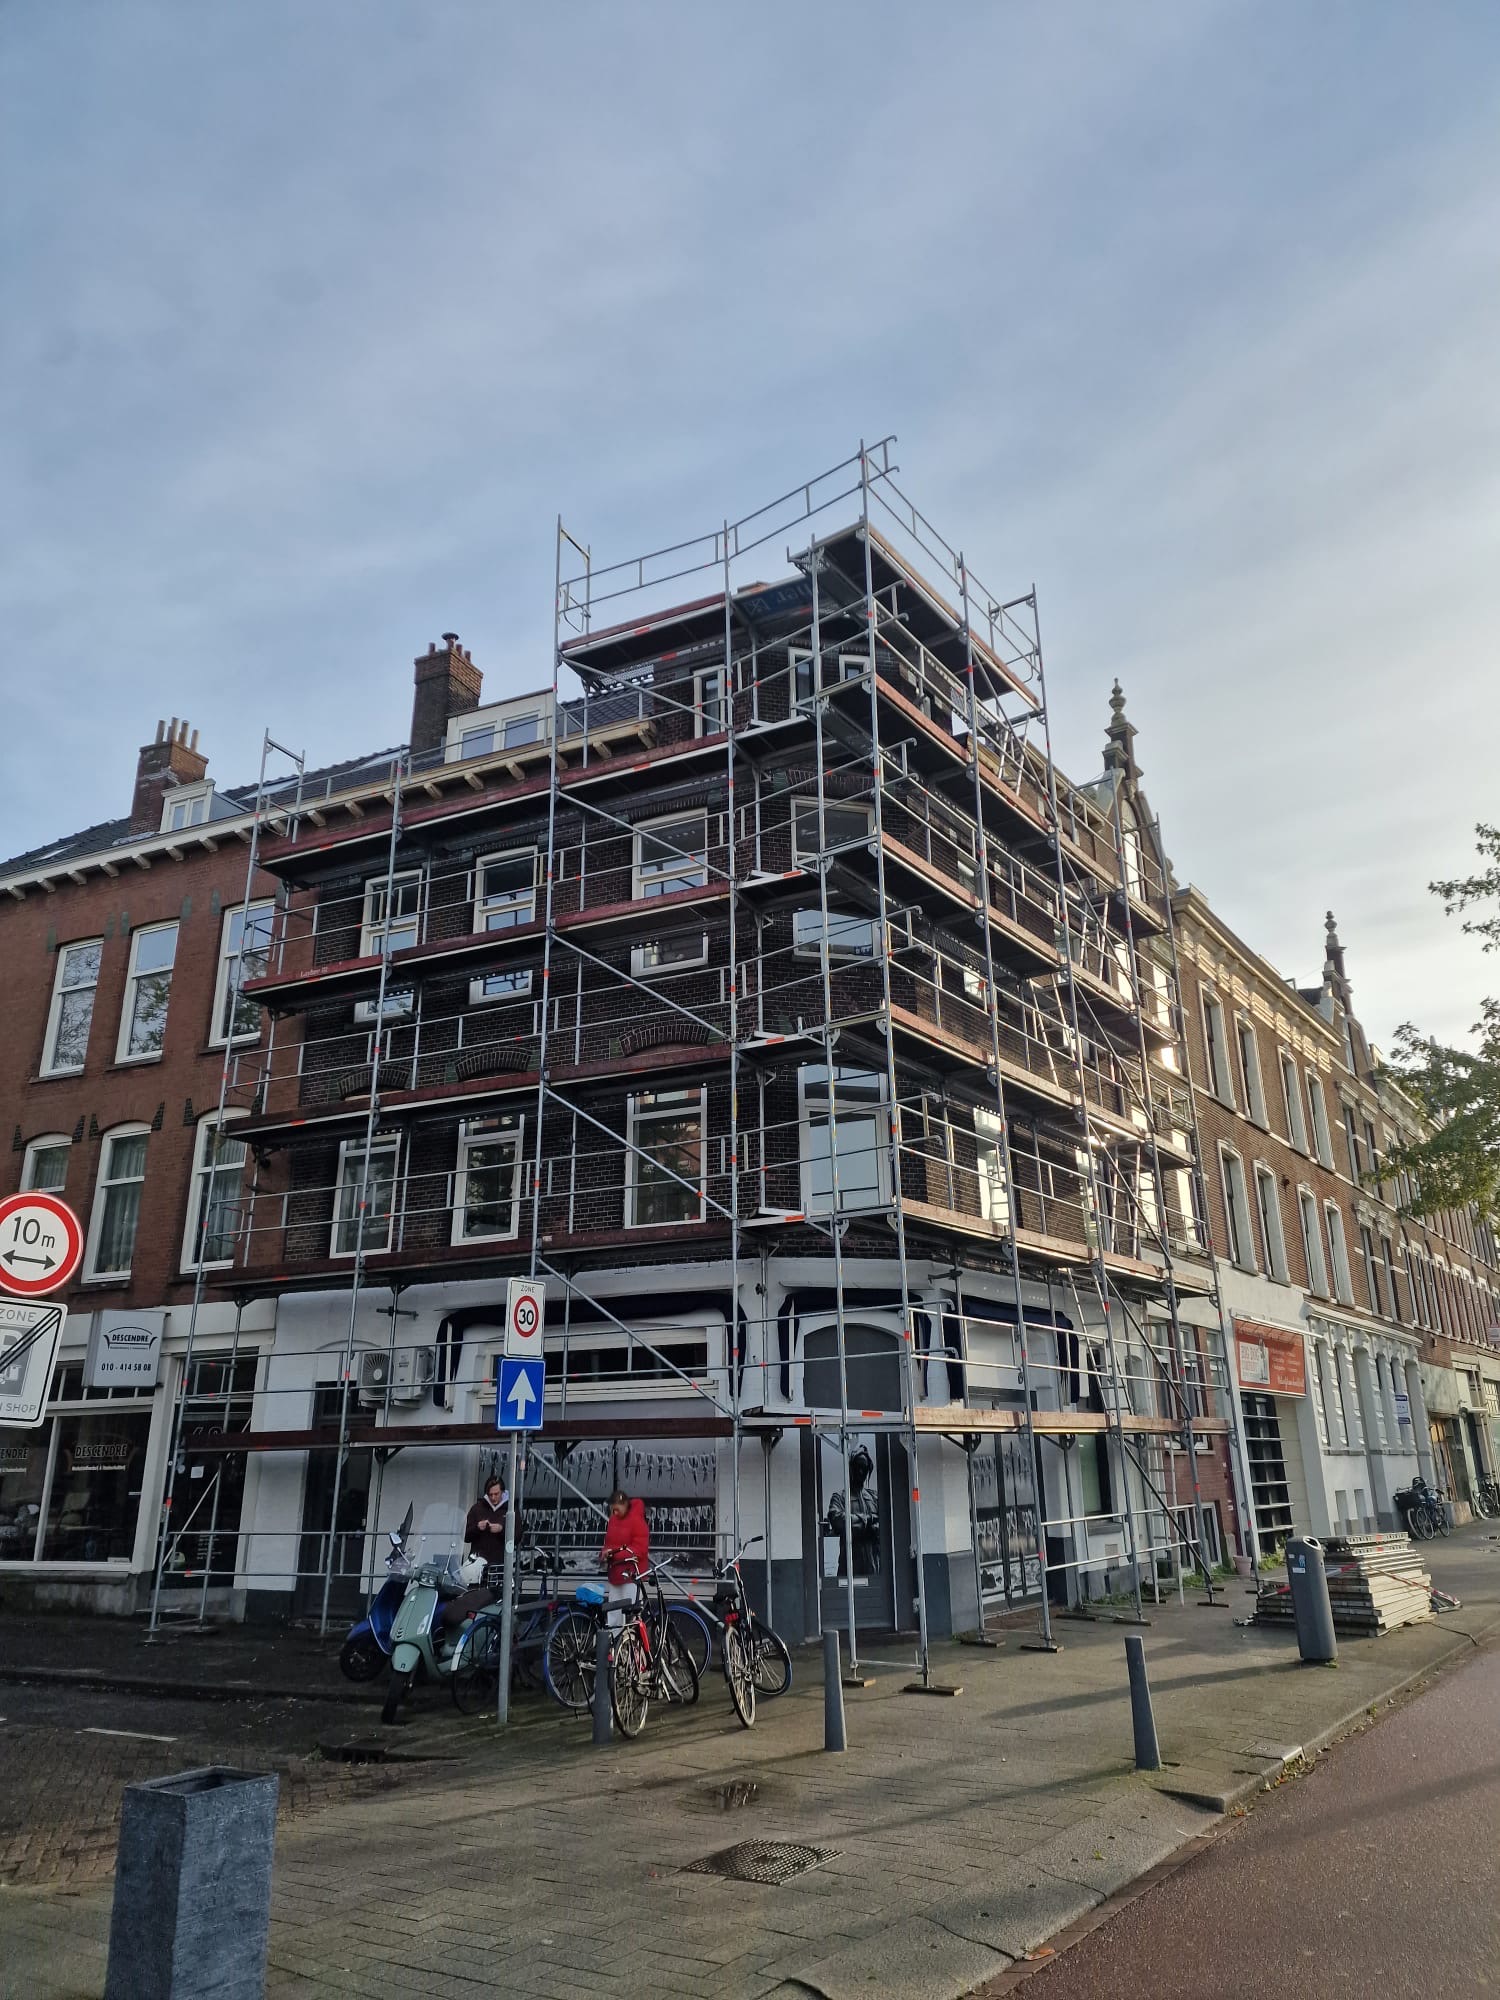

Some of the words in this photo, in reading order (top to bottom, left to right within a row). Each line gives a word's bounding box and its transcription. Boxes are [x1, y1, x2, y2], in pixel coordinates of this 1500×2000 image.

[521, 1285, 535, 1293] ZONE
[519, 1308, 534, 1325] 30
[112, 1334, 149, 1342] DESCENDRE
[101, 1363, 114, 1371] 010
[120, 1363, 132, 1371] 414
[6, 1402, 37, 1413] SHOP
[75, 1444, 127, 1459] DESCENDRE
